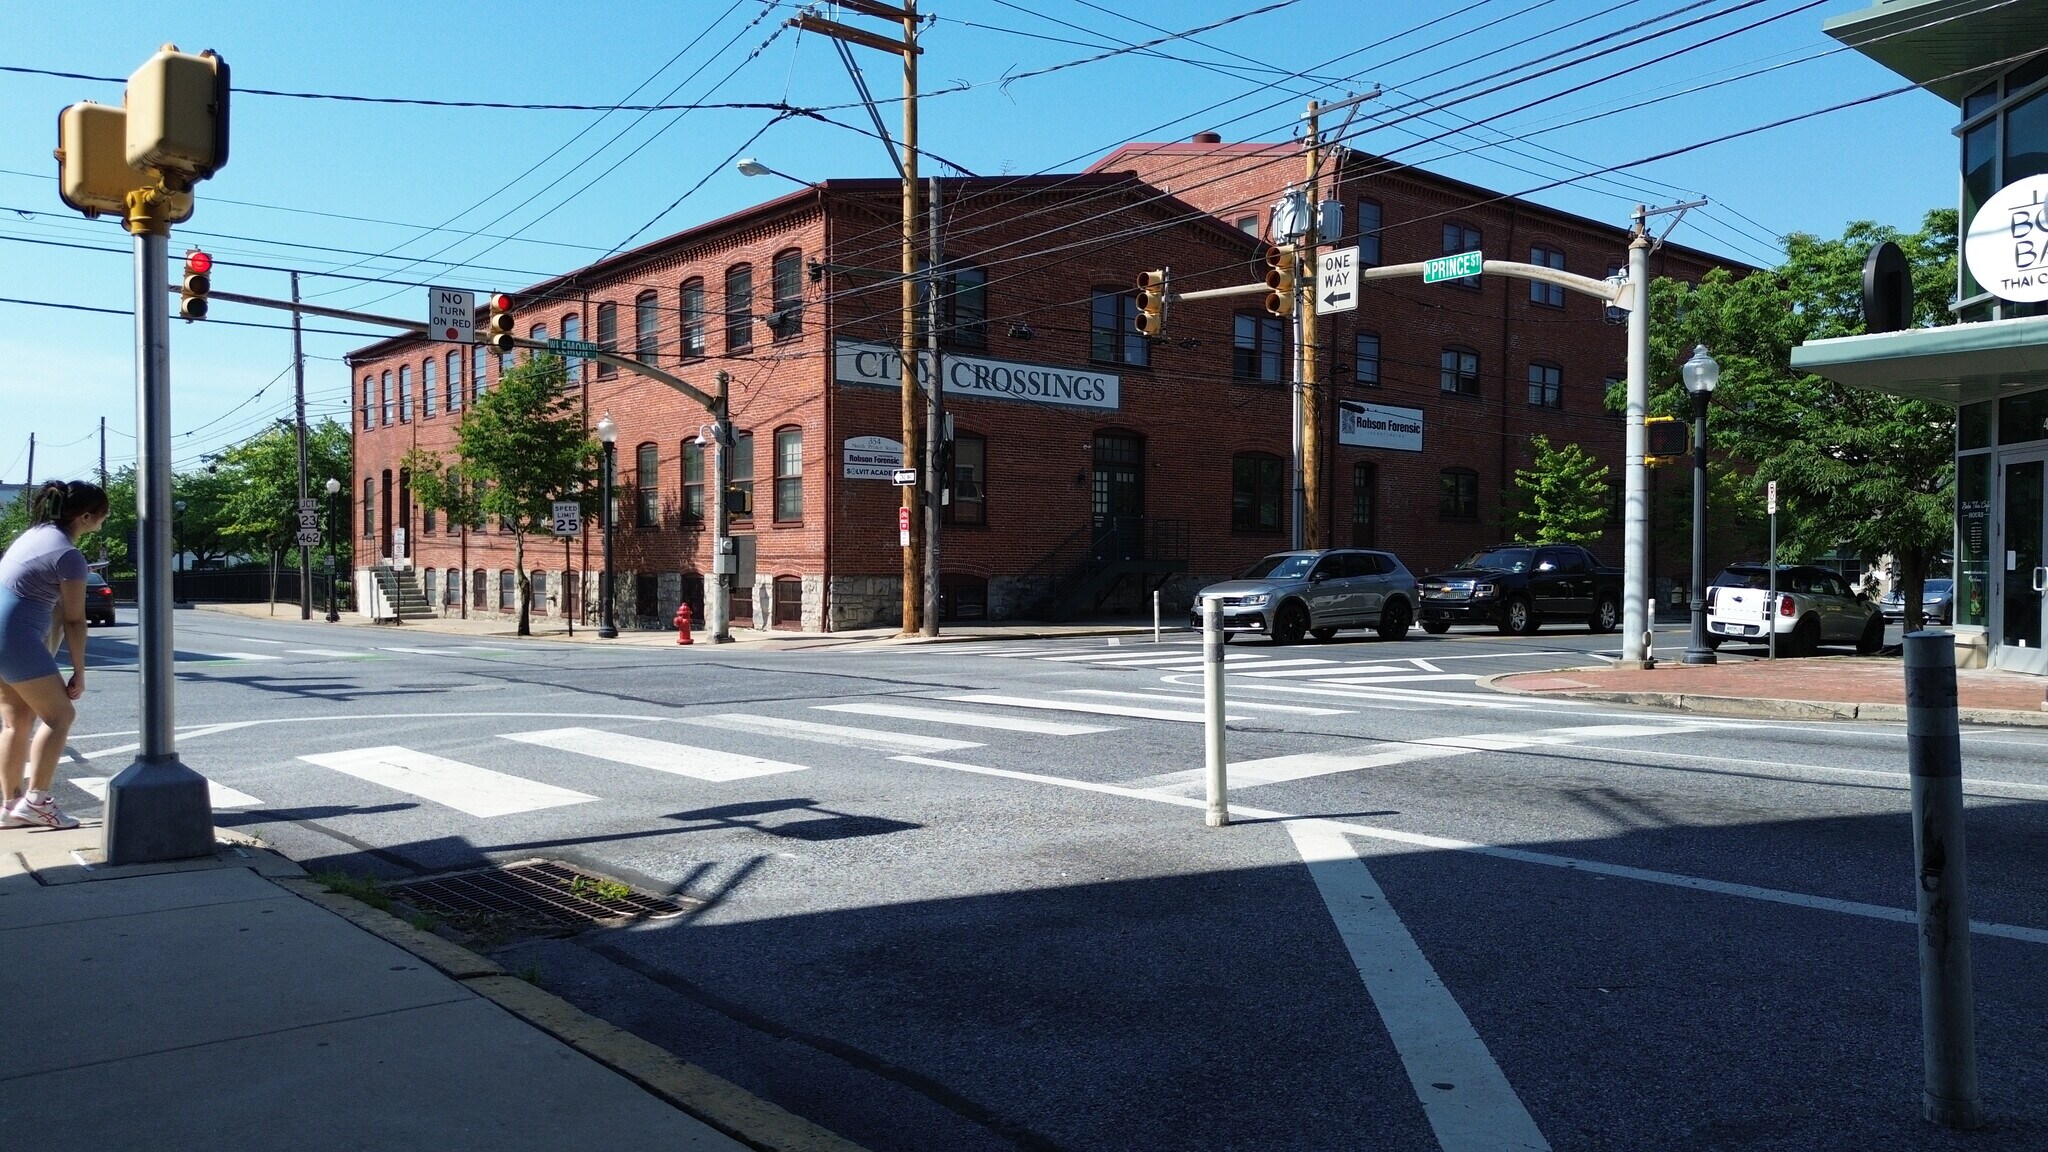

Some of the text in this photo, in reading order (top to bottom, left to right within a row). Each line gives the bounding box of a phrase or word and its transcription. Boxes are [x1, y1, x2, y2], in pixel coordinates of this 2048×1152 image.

[1325, 254, 1350, 271] ONE
[1425, 253, 1480, 280] N PRINCE ST
[1325, 271, 1350, 288] WAY
[2001, 275, 2033, 290] THAI
[441, 292, 463, 304] NO
[439, 305, 466, 317] TURN
[433, 316, 471, 329] ON RED
[556, 341, 589, 357] LEMON
[950, 362, 1105, 401] CROSSINGS
[1356, 416, 1421, 434] Robson Forensic
[868, 437, 881, 446] 354
[849, 454, 873, 463] Robson
[873, 455, 900, 465] Forensic
[301, 500, 315, 508] JCT
[301, 515, 317, 526] 23
[556, 519, 578, 532] 25
[298, 532, 319, 543] 462
